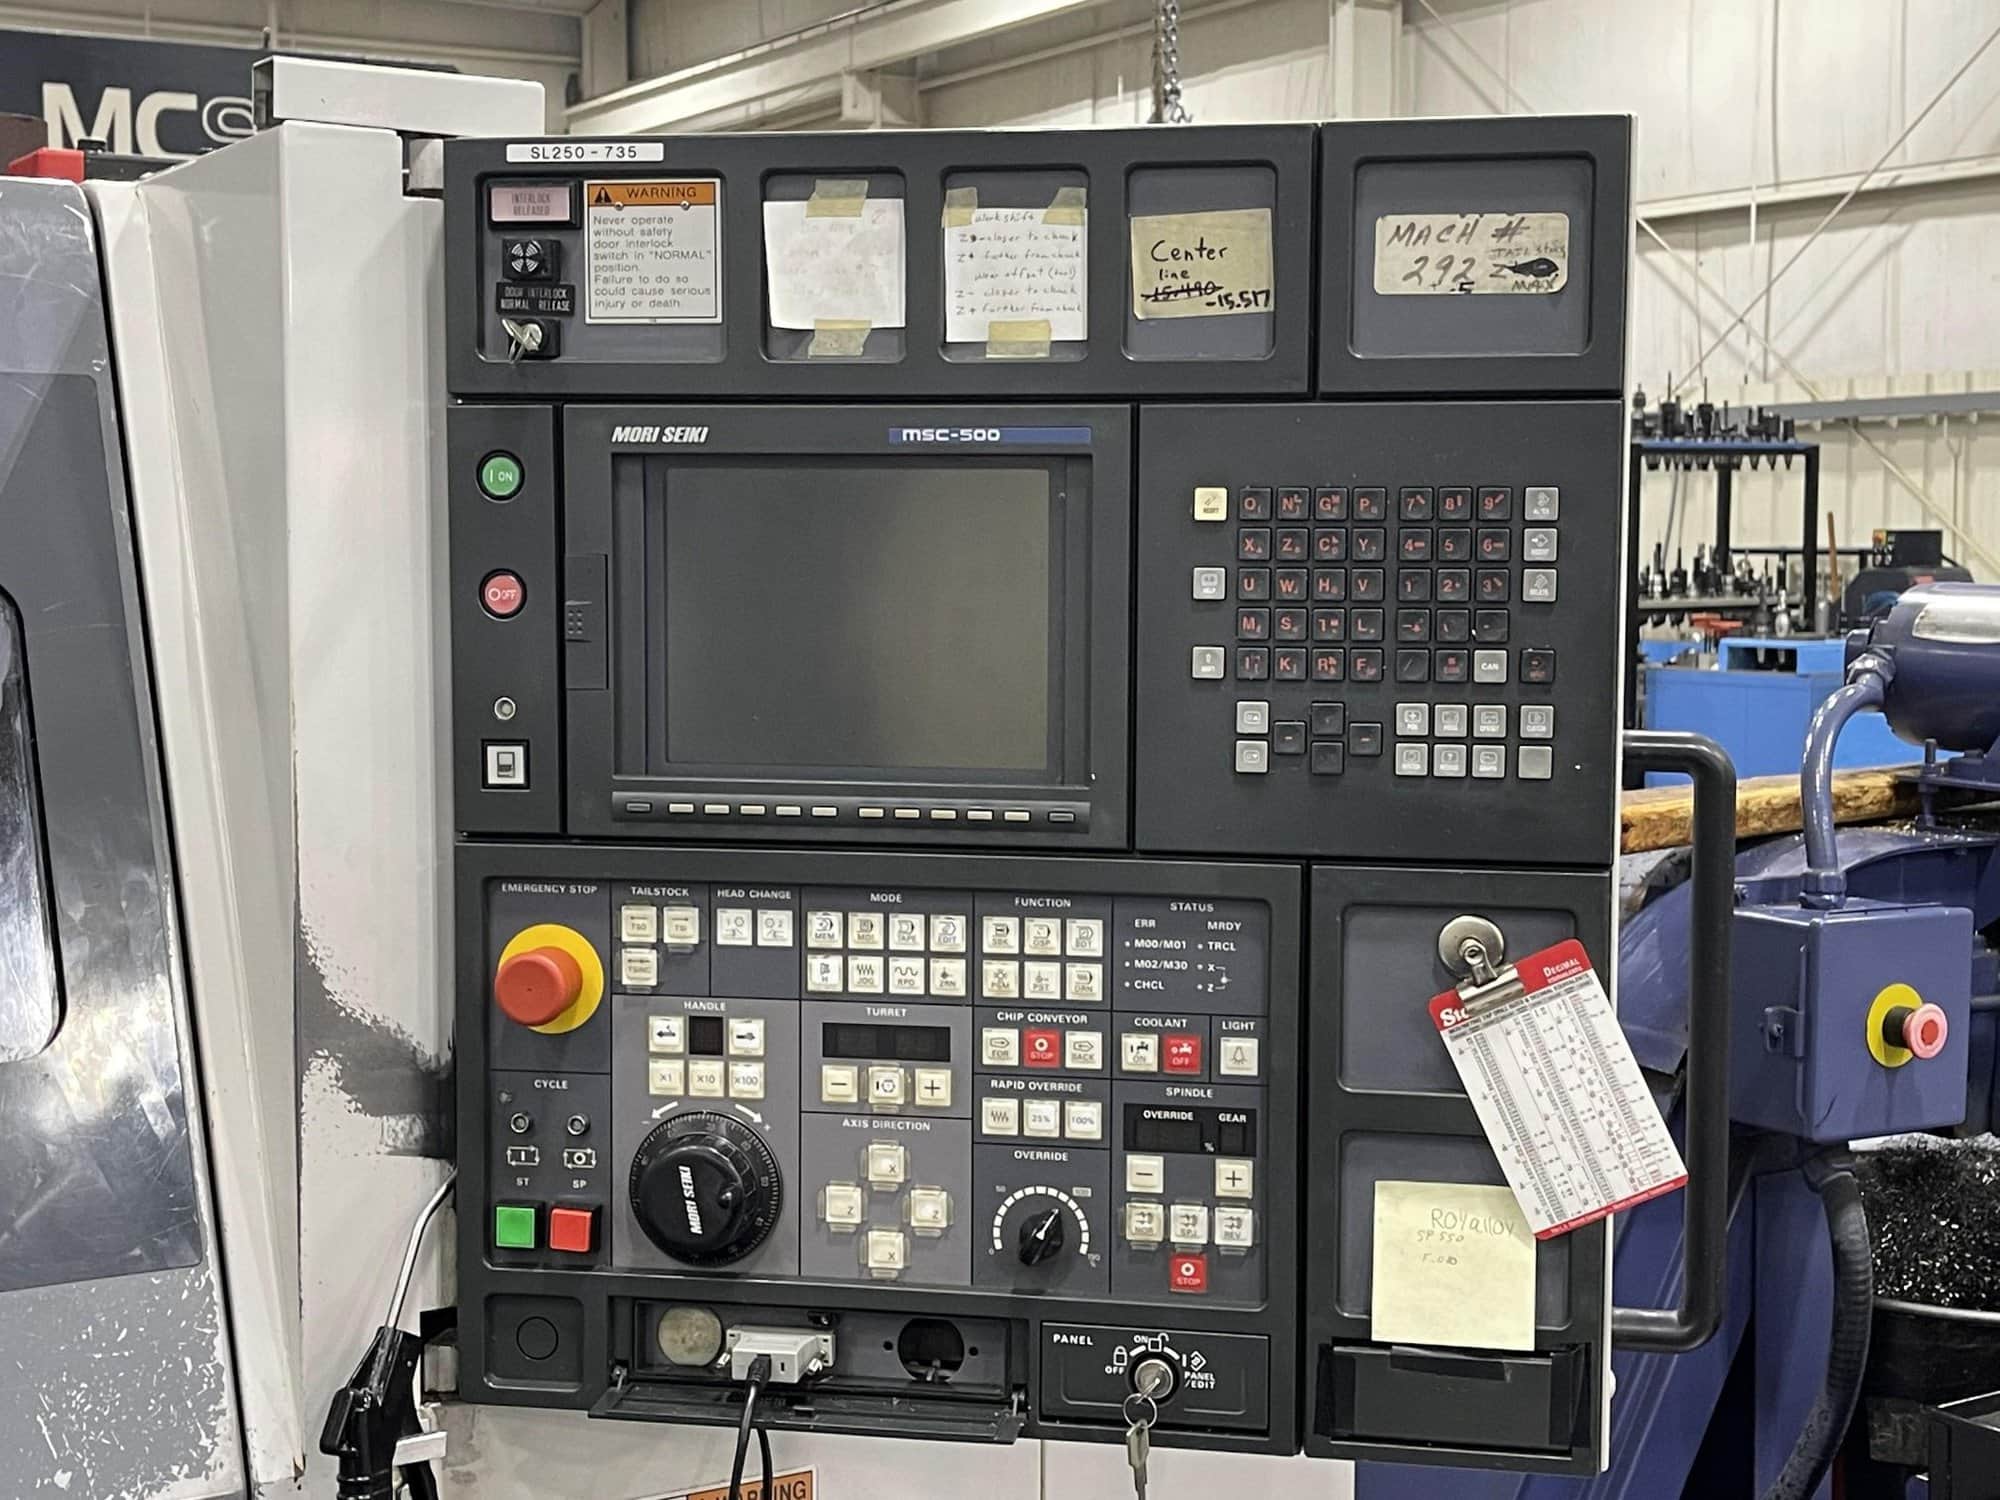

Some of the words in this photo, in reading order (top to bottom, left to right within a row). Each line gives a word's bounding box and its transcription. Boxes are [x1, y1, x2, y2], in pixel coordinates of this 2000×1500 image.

[531, 146, 585, 160] SL250
[605, 146, 637, 159] 735
[626, 187, 697, 199] WARNING
[593, 216, 625, 225] Never
[631, 216, 673, 227] operate
[593, 227, 634, 236] without
[640, 227, 673, 239] safety
[1387, 217, 1480, 247] MACH
[594, 239, 620, 248] door
[626, 239, 673, 248] interlock
[594, 250, 628, 260] switch
[634, 250, 644, 260] in
[649, 249, 711, 260] "NORMAL"
[1151, 237, 1228, 263] Center
[594, 274, 633, 284] Failure
[639, 275, 649, 284] to
[655, 274, 670, 284] do
[676, 276, 689, 284] so
[1159, 268, 1190, 281] line
[594, 286, 625, 296] could
[631, 287, 664, 296] cause
[670, 287, 711, 296] serious
[594, 299, 625, 310] injury
[631, 299, 643, 308] or
[611, 426, 660, 443] MORI
[661, 426, 709, 443] SEIKI
[498, 471, 513, 482] ON
[501, 589, 516, 600] OFF
[1481, 662, 1499, 671] CAN
[501, 884, 566, 894] EMERGENCY
[569, 884, 598, 895] STOP
[631, 886, 689, 897] TAILSTOCK
[716, 889, 745, 899] HEAD
[749, 890, 792, 900] CHANGE
[869, 893, 902, 904] MODE
[1015, 897, 1072, 908] FUNCTION
[1169, 902, 1214, 912] STATUS
[1134, 919, 1156, 928] ERR
[1207, 921, 1241, 931] MRDY
[1134, 939, 1186, 949] M00/M01
[1207, 941, 1236, 951] TRCL
[1134, 959, 1188, 970] M02/M30
[1207, 963, 1216, 972] X
[1134, 980, 1165, 990] CHCL
[1207, 983, 1214, 992] Z
[683, 1001, 726, 1012] HANDLE
[865, 1007, 907, 1018] TURRET
[997, 1011, 1025, 1022] CHIP
[1027, 1013, 1088, 1025] CONVEYOR
[1134, 1017, 1188, 1028] COOLANT
[1221, 1021, 1255, 1031] LIGHT
[1030, 1052, 1054, 1060] STOP
[1172, 1058, 1190, 1066] OFF
[534, 1079, 568, 1090] CYCLE
[990, 1080, 1025, 1090] RAPID
[1028, 1081, 1083, 1093] OVERRIDE
[1166, 1087, 1214, 1098] SPINDLE
[1143, 1110, 1194, 1121] OVERRIDE
[1218, 1113, 1247, 1123] GEAR
[842, 1118, 869, 1129] AXIS
[872, 1120, 931, 1131] DIRECTION
[1014, 1150, 1069, 1162] OVERRIDE
[516, 1178, 529, 1186] ST
[572, 1180, 587, 1189] SP
[678, 1165, 695, 1199] SEIKI
[685, 1200, 703, 1235] MORI
[1176, 1277, 1201, 1286] STOP
[1053, 1333, 1094, 1346] PANEL
[1134, 1335, 1148, 1344] ON
[1105, 1366, 1125, 1375] OFF
[1184, 1371, 1216, 1382] PANEL
[1184, 1380, 1216, 1389] /EDIT
